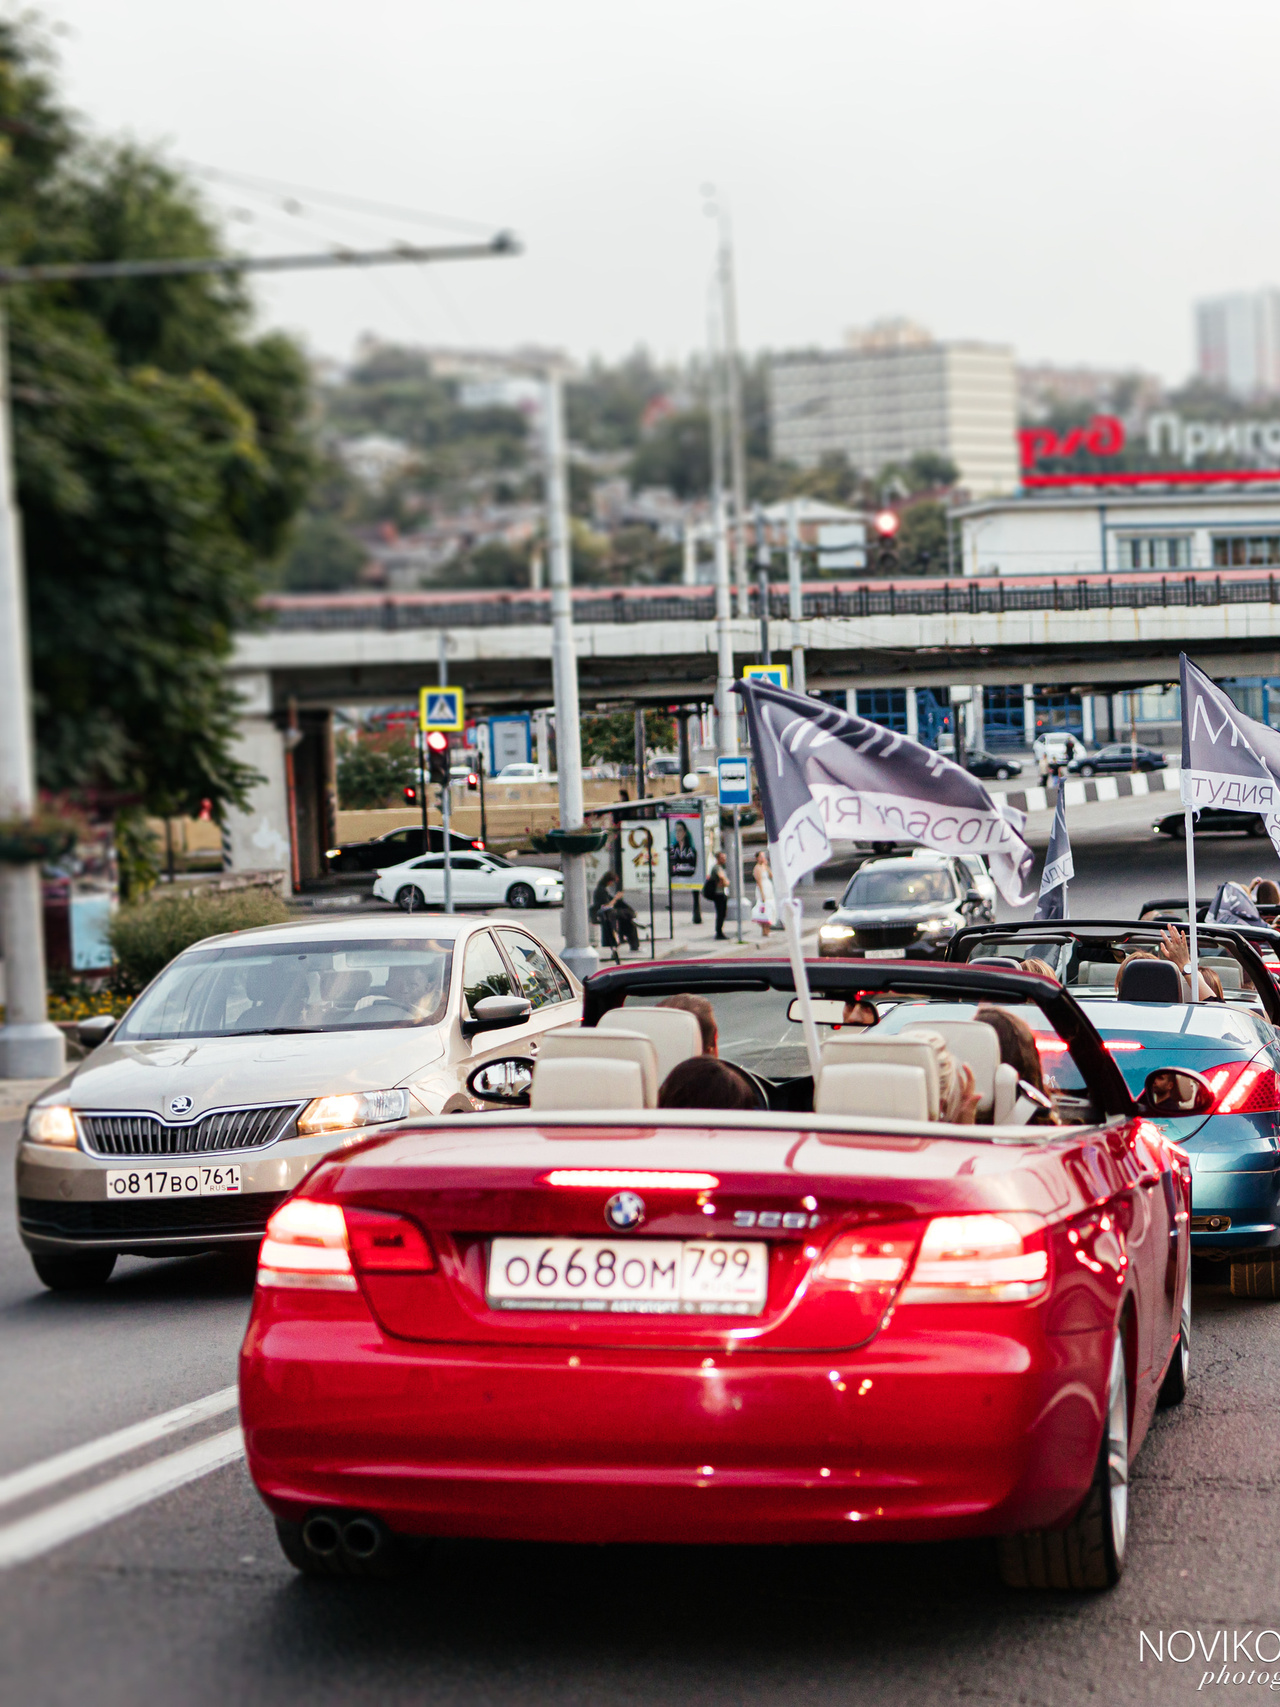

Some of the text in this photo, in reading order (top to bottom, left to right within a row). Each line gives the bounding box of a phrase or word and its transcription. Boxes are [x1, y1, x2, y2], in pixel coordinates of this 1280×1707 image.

[1191, 777, 1274, 807] тудия
[113, 1168, 235, 1194] О817ВО 761
[209, 1184, 227, 1192] RUS
[505, 1247, 751, 1289] О668ОМ 799
